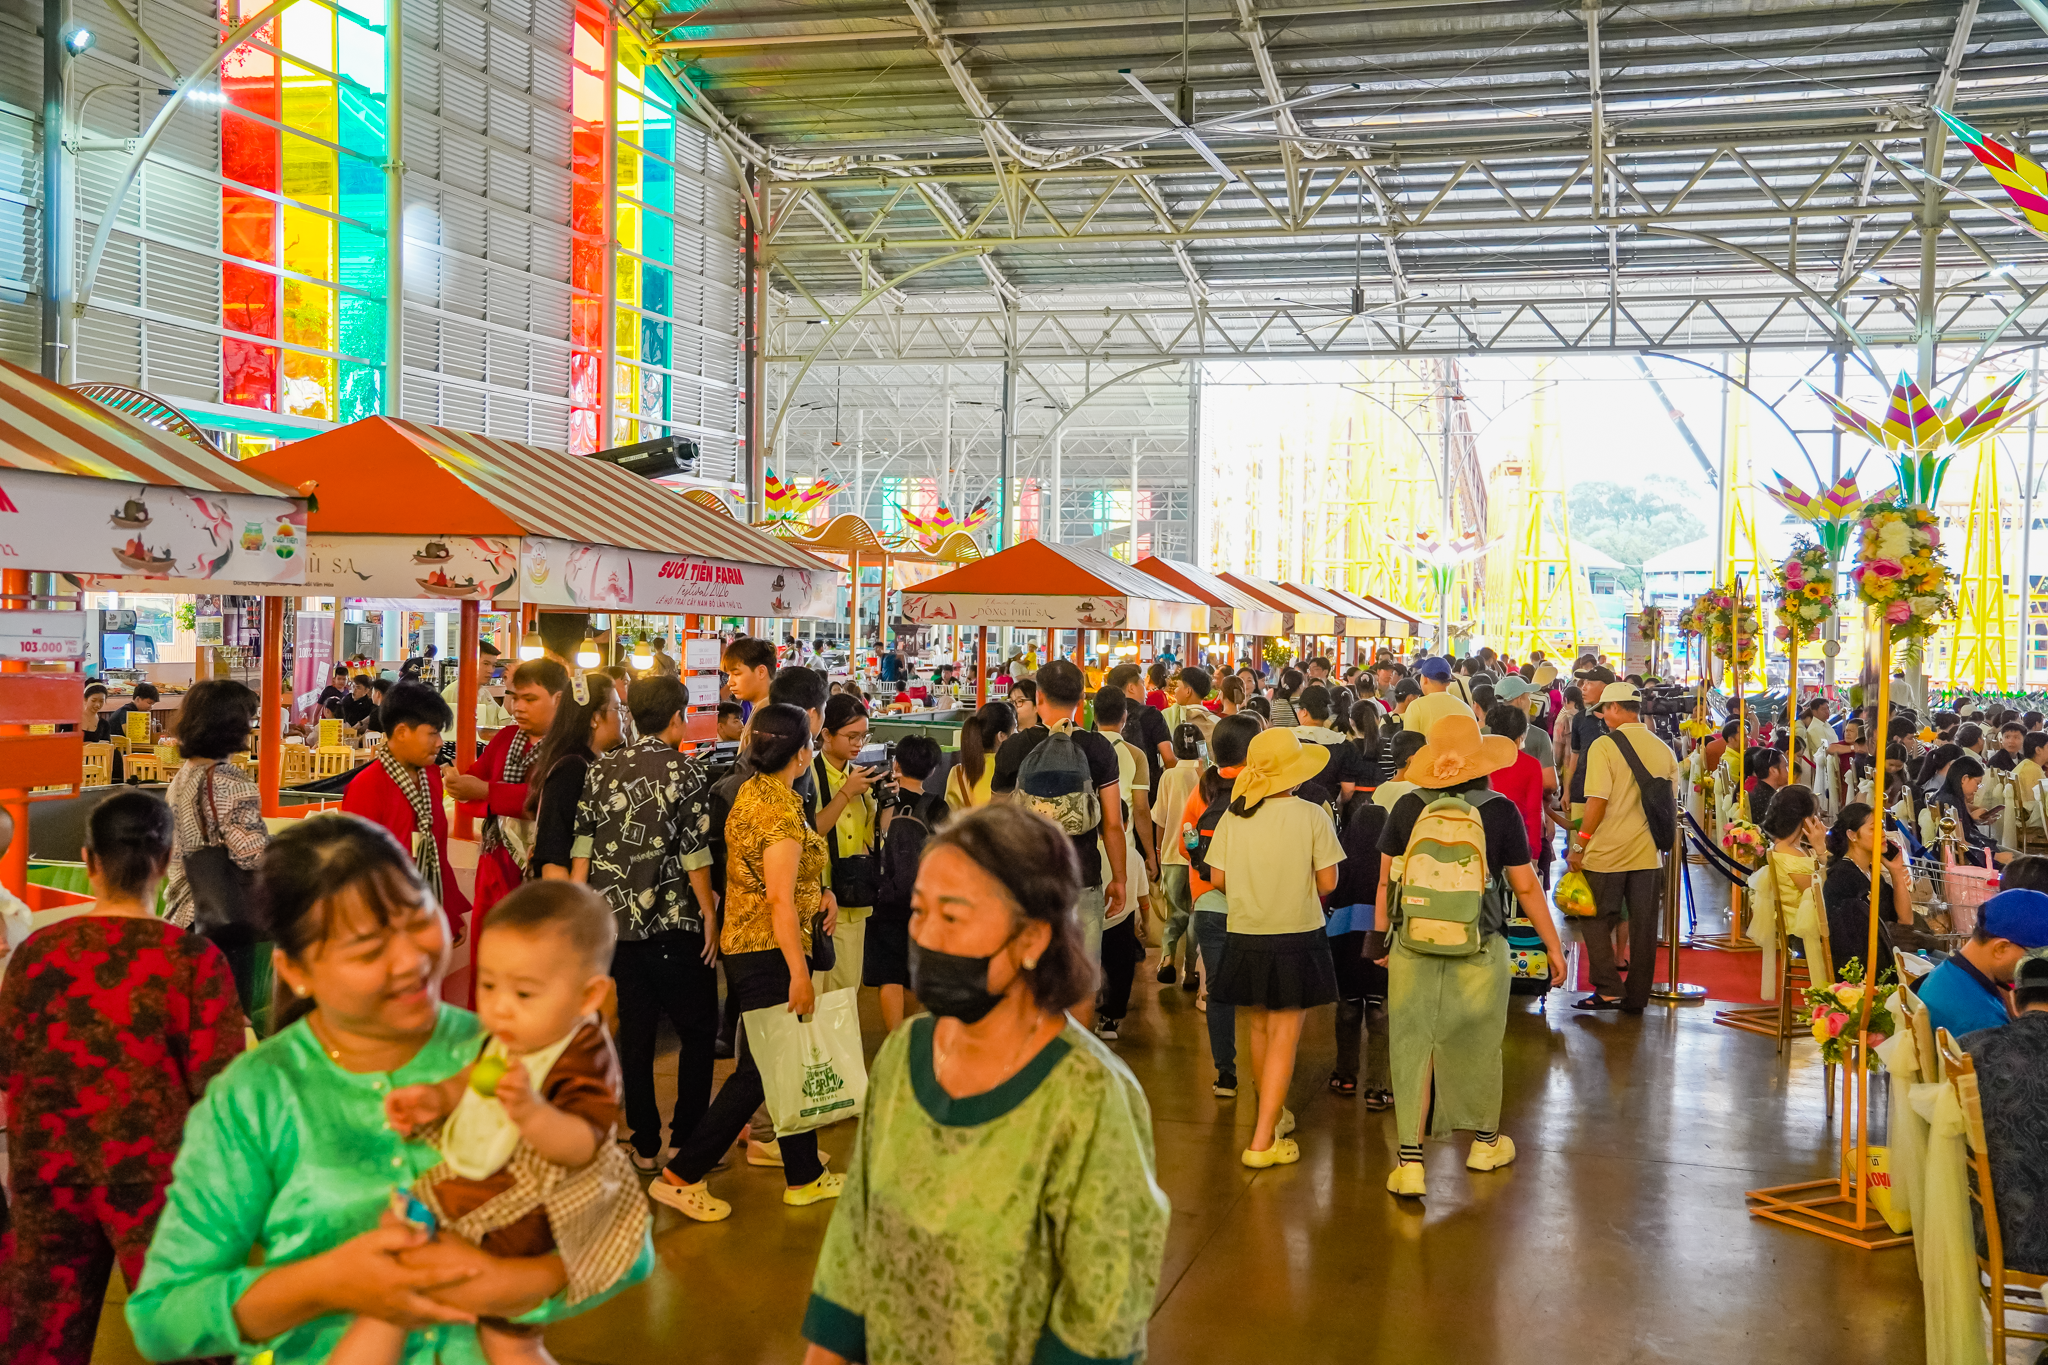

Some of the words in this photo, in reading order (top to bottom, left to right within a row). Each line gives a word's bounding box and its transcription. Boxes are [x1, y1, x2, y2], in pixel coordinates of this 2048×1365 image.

[657, 556, 689, 580] SUỐI
[690, 560, 714, 582] TIÊN
[715, 566, 744, 586] FARM
[677, 579, 709, 598] Festival
[709, 581, 729, 598] 2026
[697, 599, 708, 607] NAM
[708, 598, 716, 609] BỘ
[20, 641, 62, 652] 103.000
[299, 647, 313, 658] 100%
[808, 1073, 837, 1092] FARM
